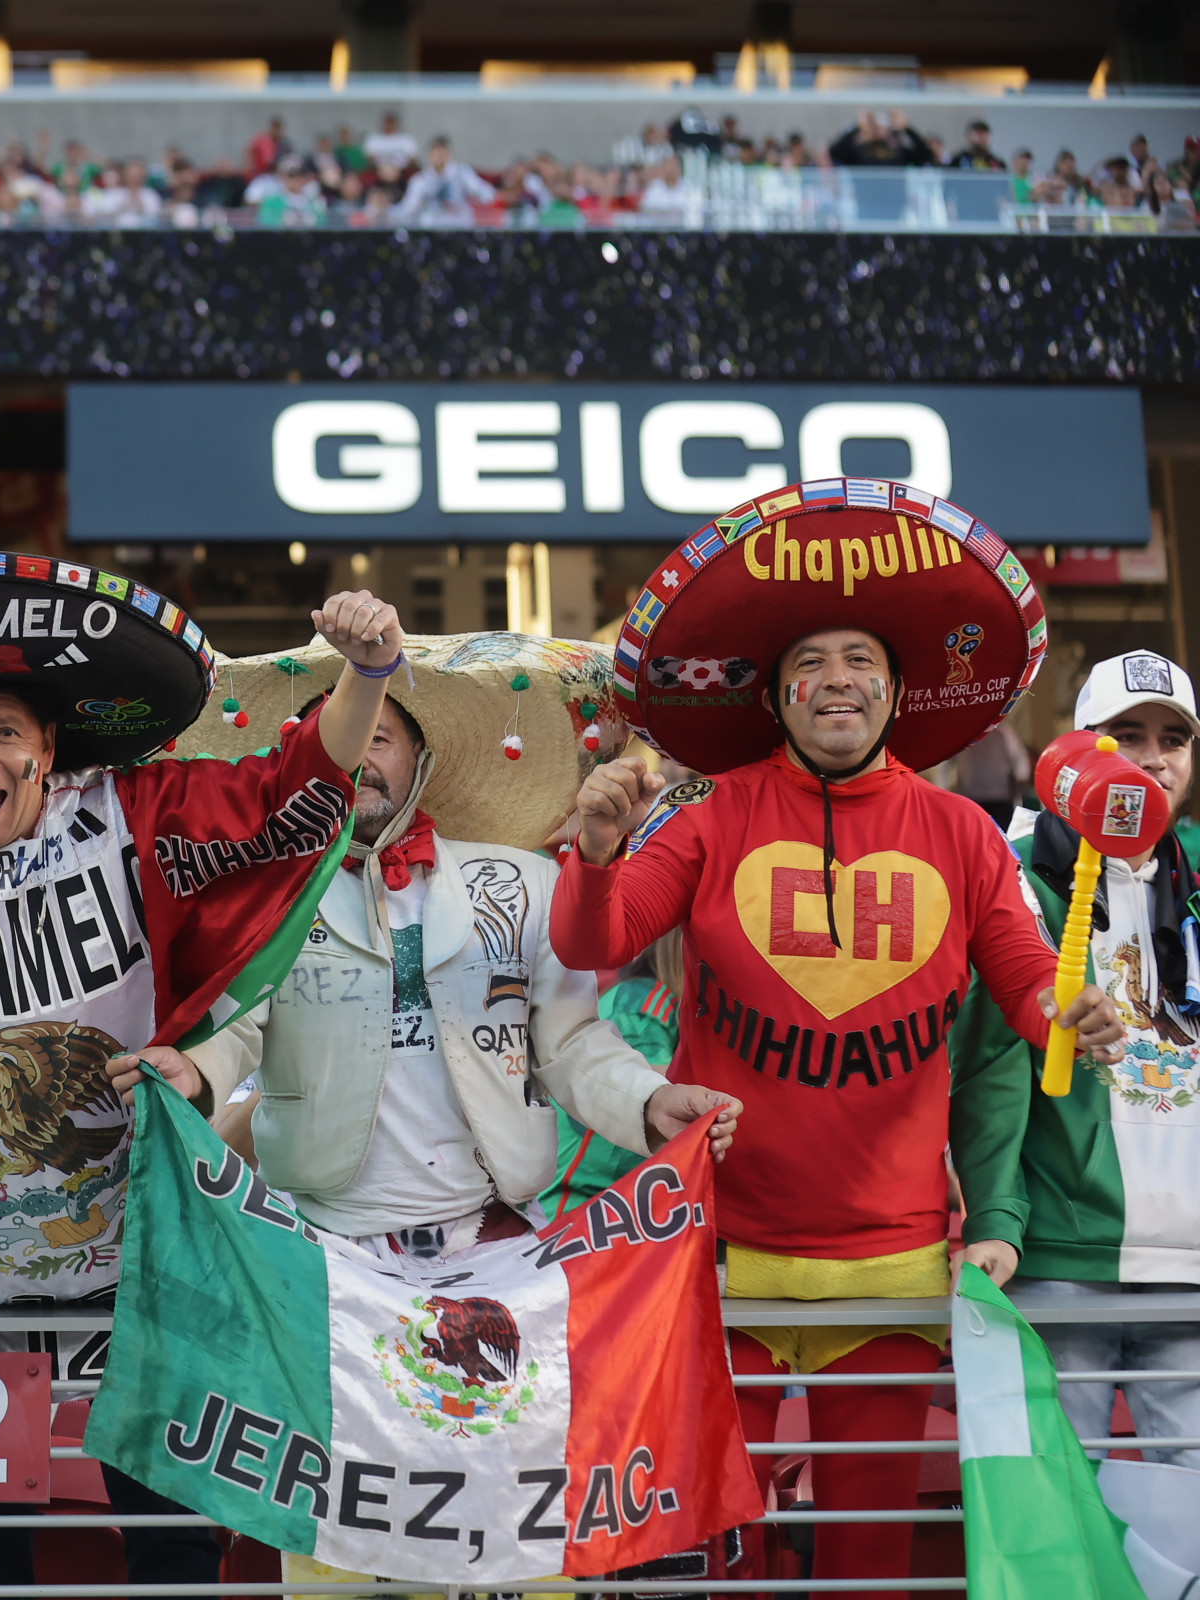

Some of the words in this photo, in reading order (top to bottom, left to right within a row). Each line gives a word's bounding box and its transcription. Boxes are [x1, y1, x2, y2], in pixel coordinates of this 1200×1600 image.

[272, 400, 953, 514] GEICO
[743, 515, 963, 596] Chapulin
[65, 717, 171, 731] GERMANY
[907, 688, 933, 702] FIFA
[939, 682, 982, 699] WORLD
[986, 676, 1011, 693] CUP
[907, 697, 967, 713] RUSSIA
[968, 690, 1005, 706] 2018
[769, 866, 915, 962] CH
[516, 1163, 707, 1271] ZAC.
[164, 1390, 485, 1565] JEREZ,
[516, 1445, 681, 1543] ZAC.
